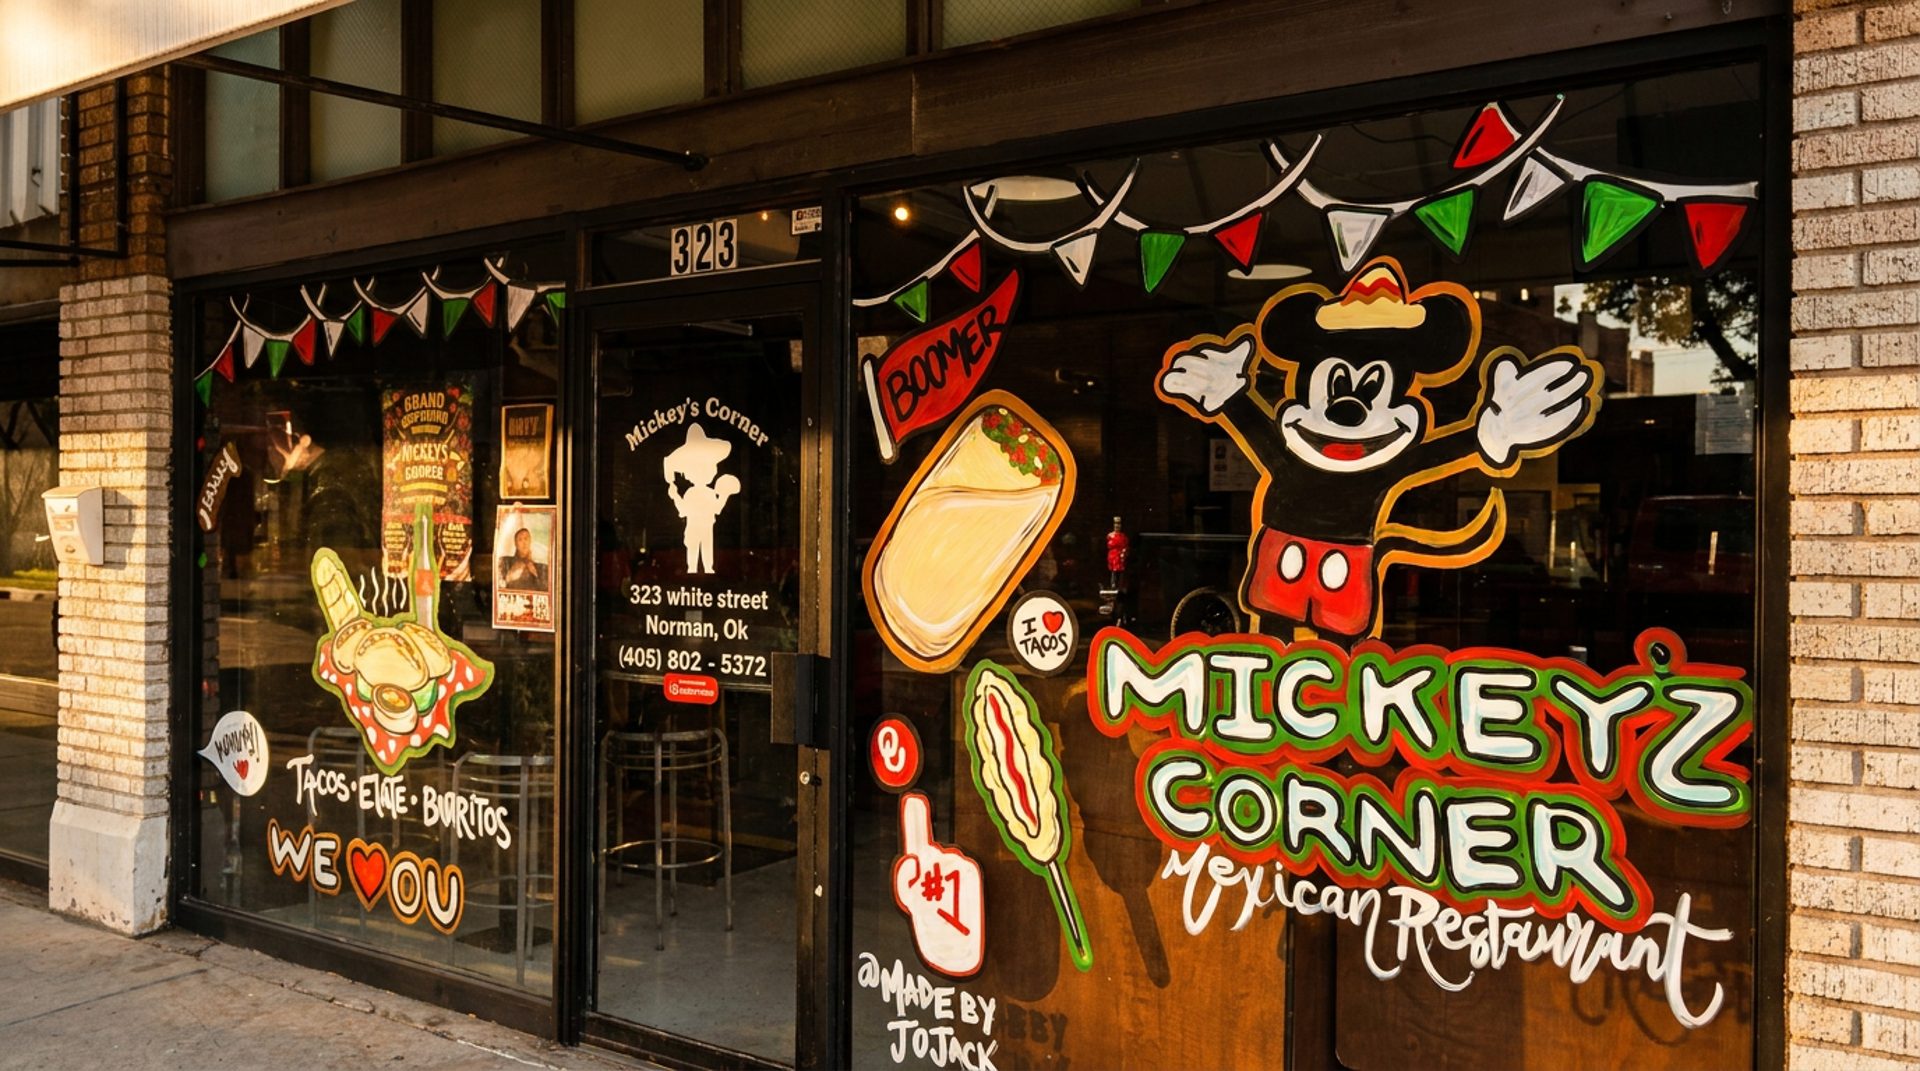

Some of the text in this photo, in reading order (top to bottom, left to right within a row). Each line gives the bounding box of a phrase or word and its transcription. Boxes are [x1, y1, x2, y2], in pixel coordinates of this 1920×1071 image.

[673, 222, 735, 274] 323
[886, 305, 1006, 422] BOOMER
[625, 397, 769, 451] Mickey's Corner
[630, 584, 769, 611] 323 white street
[645, 614, 749, 642] Norman, Ok
[1019, 633, 1068, 658] TACOS
[1022, 617, 1037, 636] I
[619, 645, 661, 671] (405)
[667, 650, 702, 672] 802
[720, 653, 767, 677] 5372
[1146, 757, 1643, 916] CORNER
[269, 823, 461, 930] WE OU
[921, 862, 971, 937] #1
[1162, 842, 1735, 1029] Mexican Restaurant
